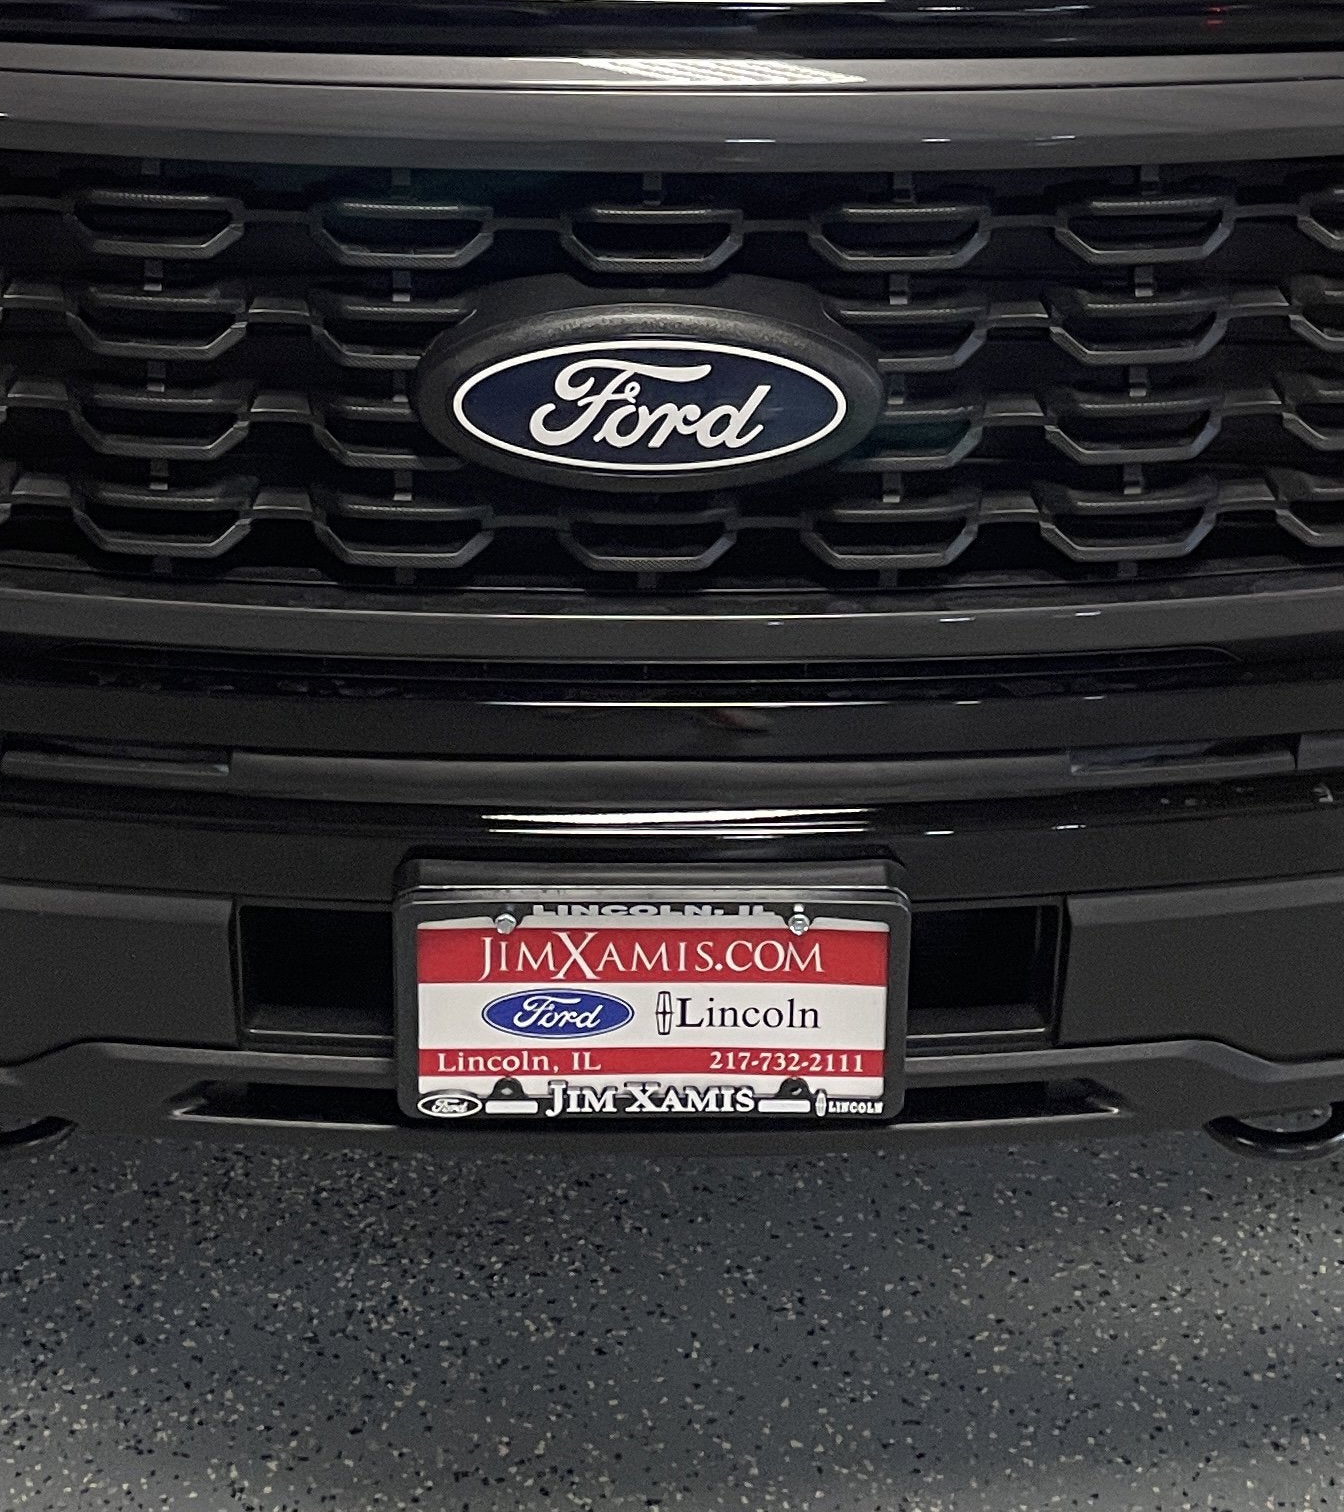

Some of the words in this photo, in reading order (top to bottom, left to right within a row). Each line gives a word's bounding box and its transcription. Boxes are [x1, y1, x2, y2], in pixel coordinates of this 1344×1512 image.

[529, 358, 772, 449] Ford
[478, 931, 824, 981] JIMXAMIS.COM
[513, 995, 604, 1029] Ford
[676, 998, 821, 1030] Lincoln
[437, 1051, 559, 1073] Lincoln,
[572, 1051, 602, 1071] IL
[709, 1051, 864, 1073] 217-732-2111
[431, 1098, 468, 1114] Ford
[545, 1082, 618, 1118] JIM
[624, 1084, 755, 1114] XAMIS
[828, 1100, 884, 1115] LINCOLN
